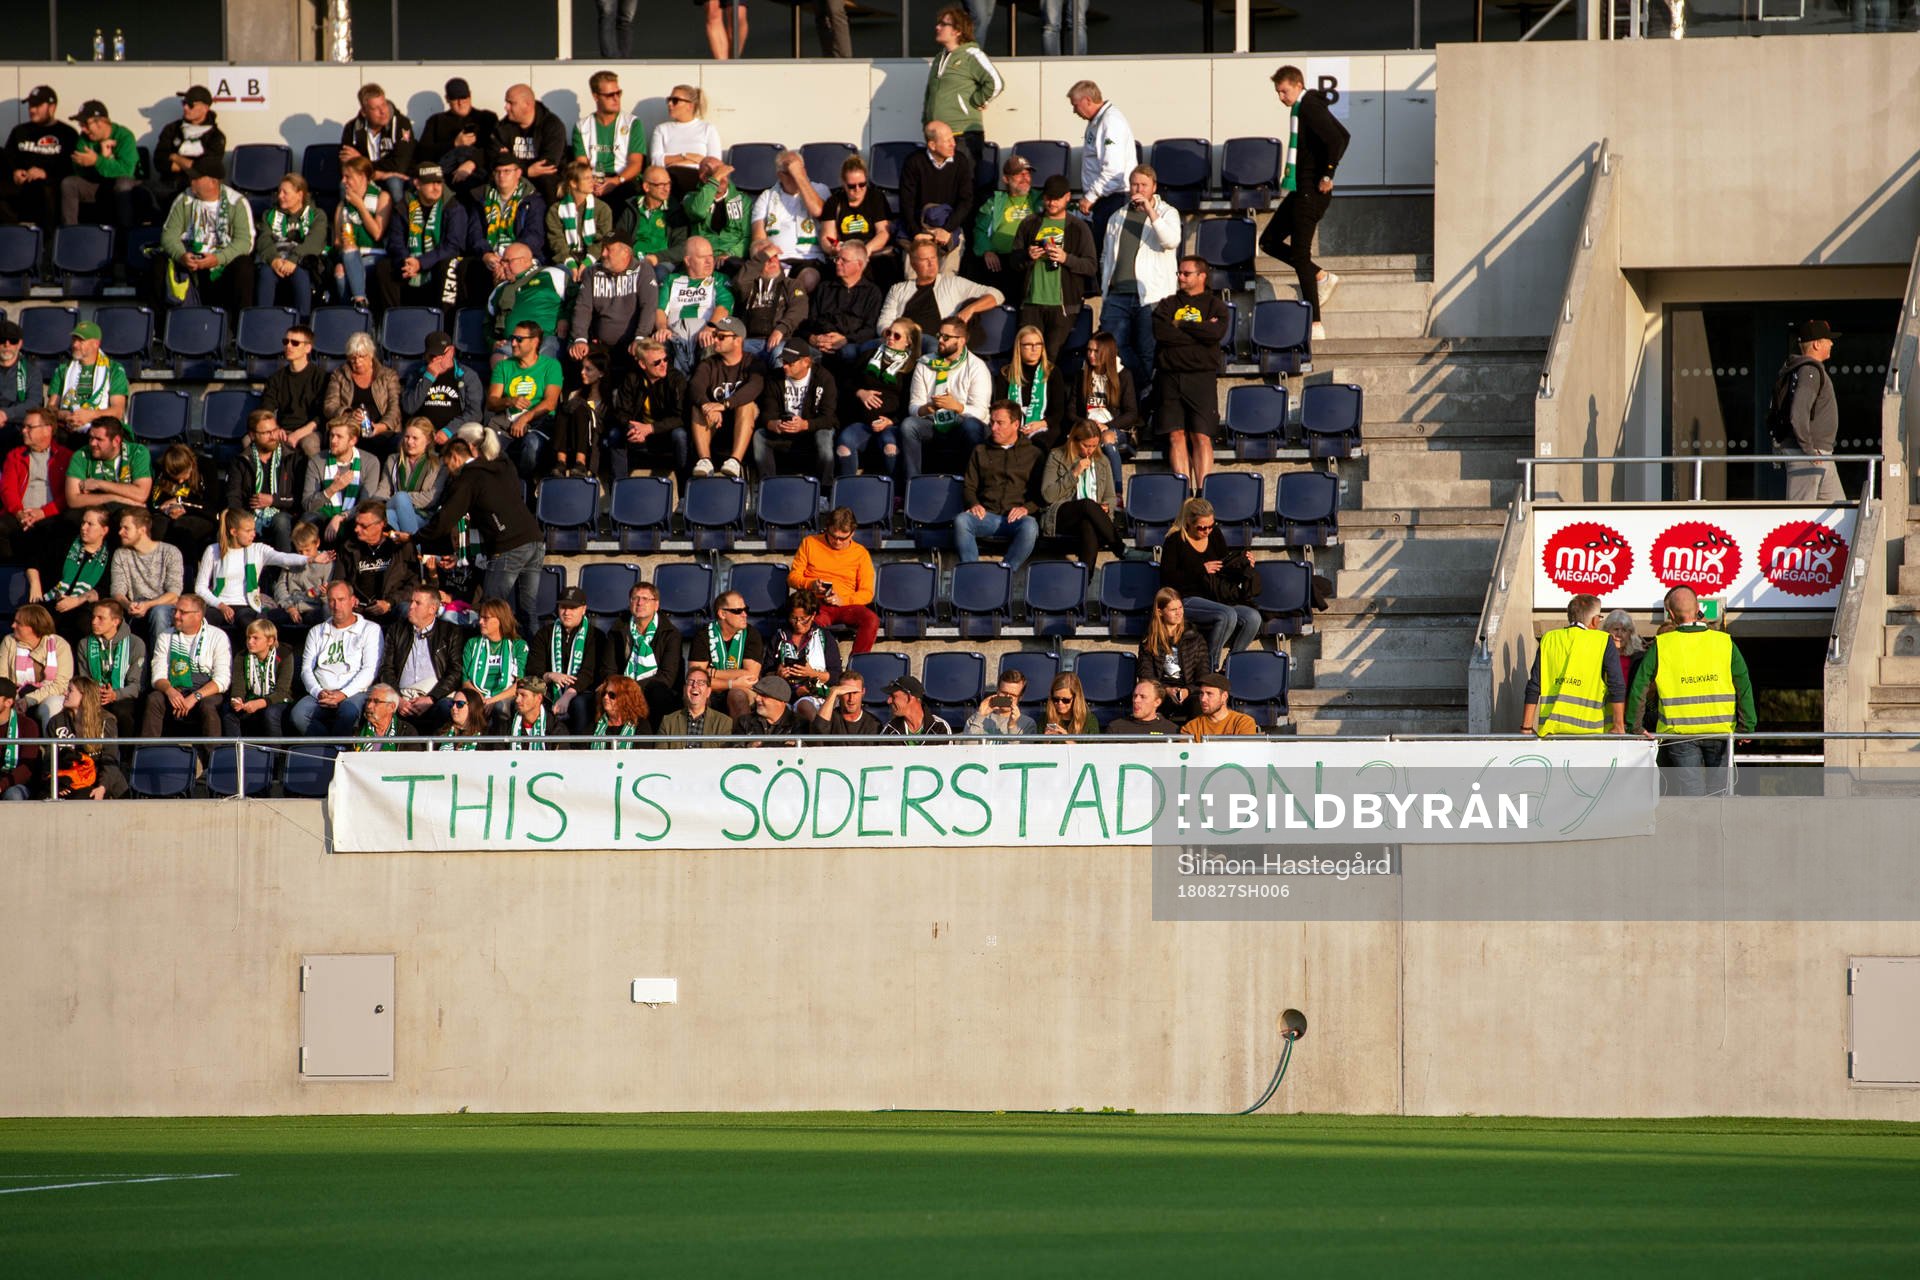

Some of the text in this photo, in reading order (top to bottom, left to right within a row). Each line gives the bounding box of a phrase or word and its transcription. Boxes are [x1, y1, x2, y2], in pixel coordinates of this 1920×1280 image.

[217, 79, 260, 96] A B
[1318, 75, 1339, 105] B
[1554, 569, 1615, 585] MEGAPOL
[1662, 569, 1723, 585] MEGAPOL
[1770, 569, 1832, 585] MEGAPOL
[1680, 674, 1719, 685] PUBLIKVÅRD
